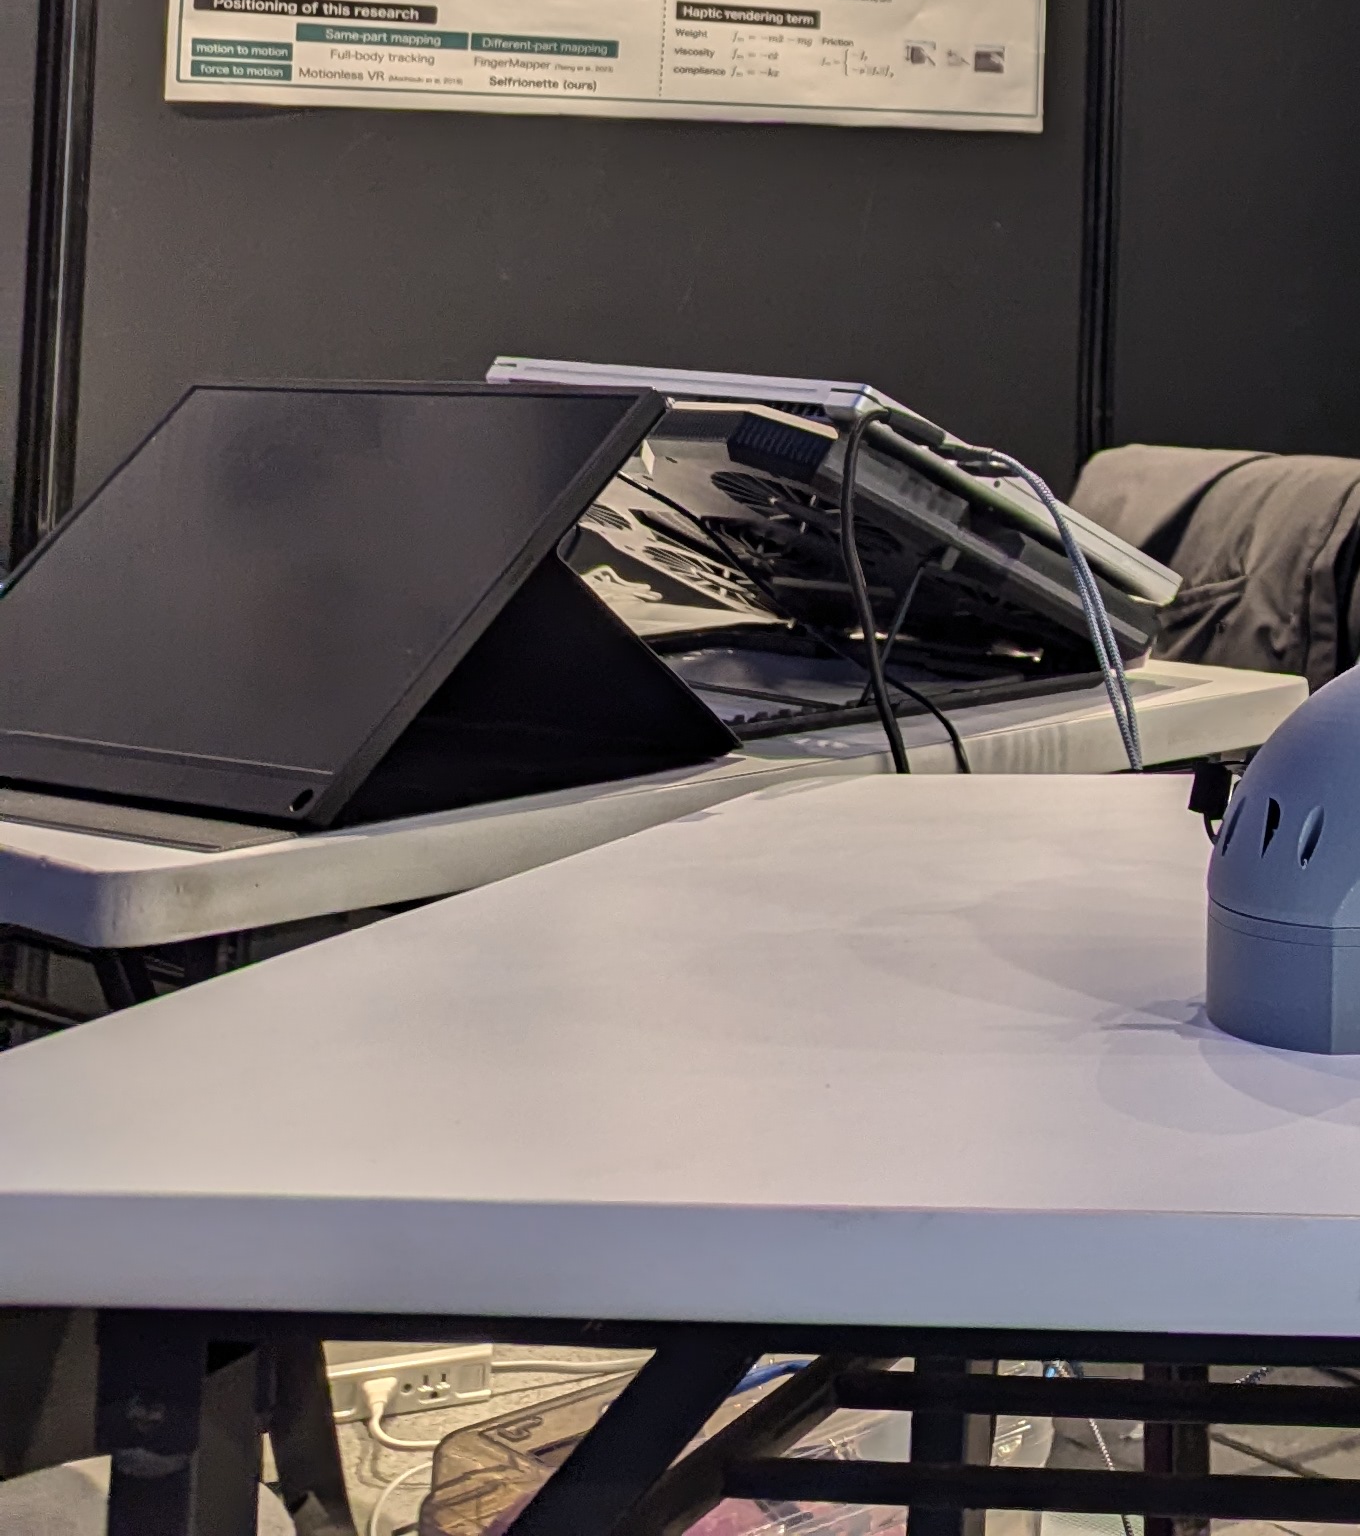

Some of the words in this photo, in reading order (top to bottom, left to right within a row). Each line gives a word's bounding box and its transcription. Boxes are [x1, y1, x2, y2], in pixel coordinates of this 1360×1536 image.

[301, 1, 319, 15] of
[321, 2, 351, 17] this
[353, 6, 420, 21] research
